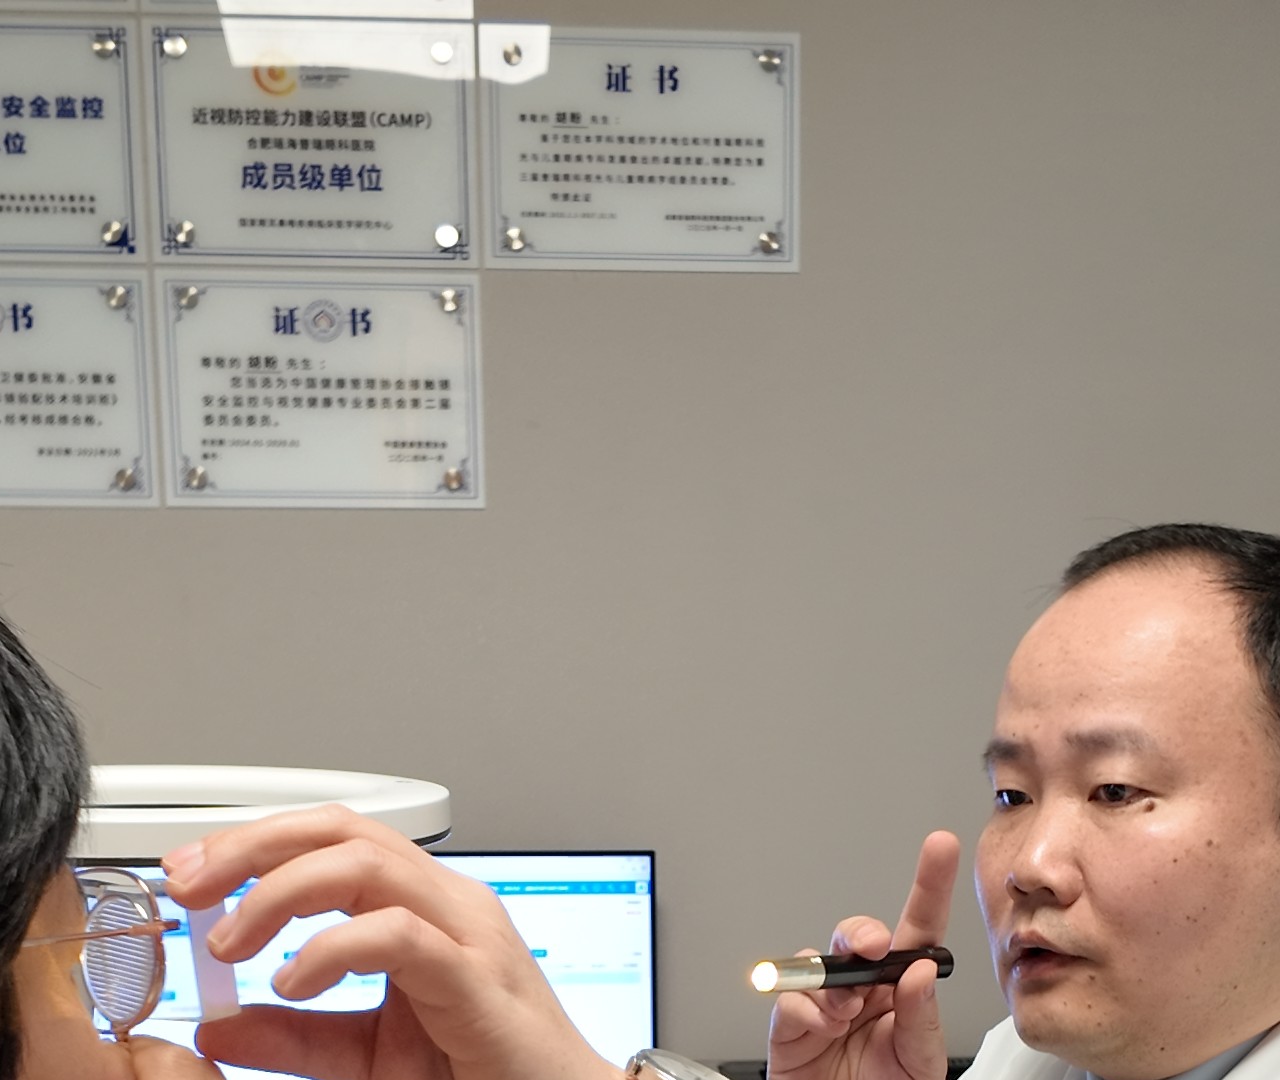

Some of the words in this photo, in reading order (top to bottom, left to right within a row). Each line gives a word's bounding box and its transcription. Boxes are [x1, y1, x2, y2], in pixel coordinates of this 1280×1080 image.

[247, 137, 376, 152] 合肥瑶海普瑞眼科医院
[241, 161, 384, 192] 成员级单位
